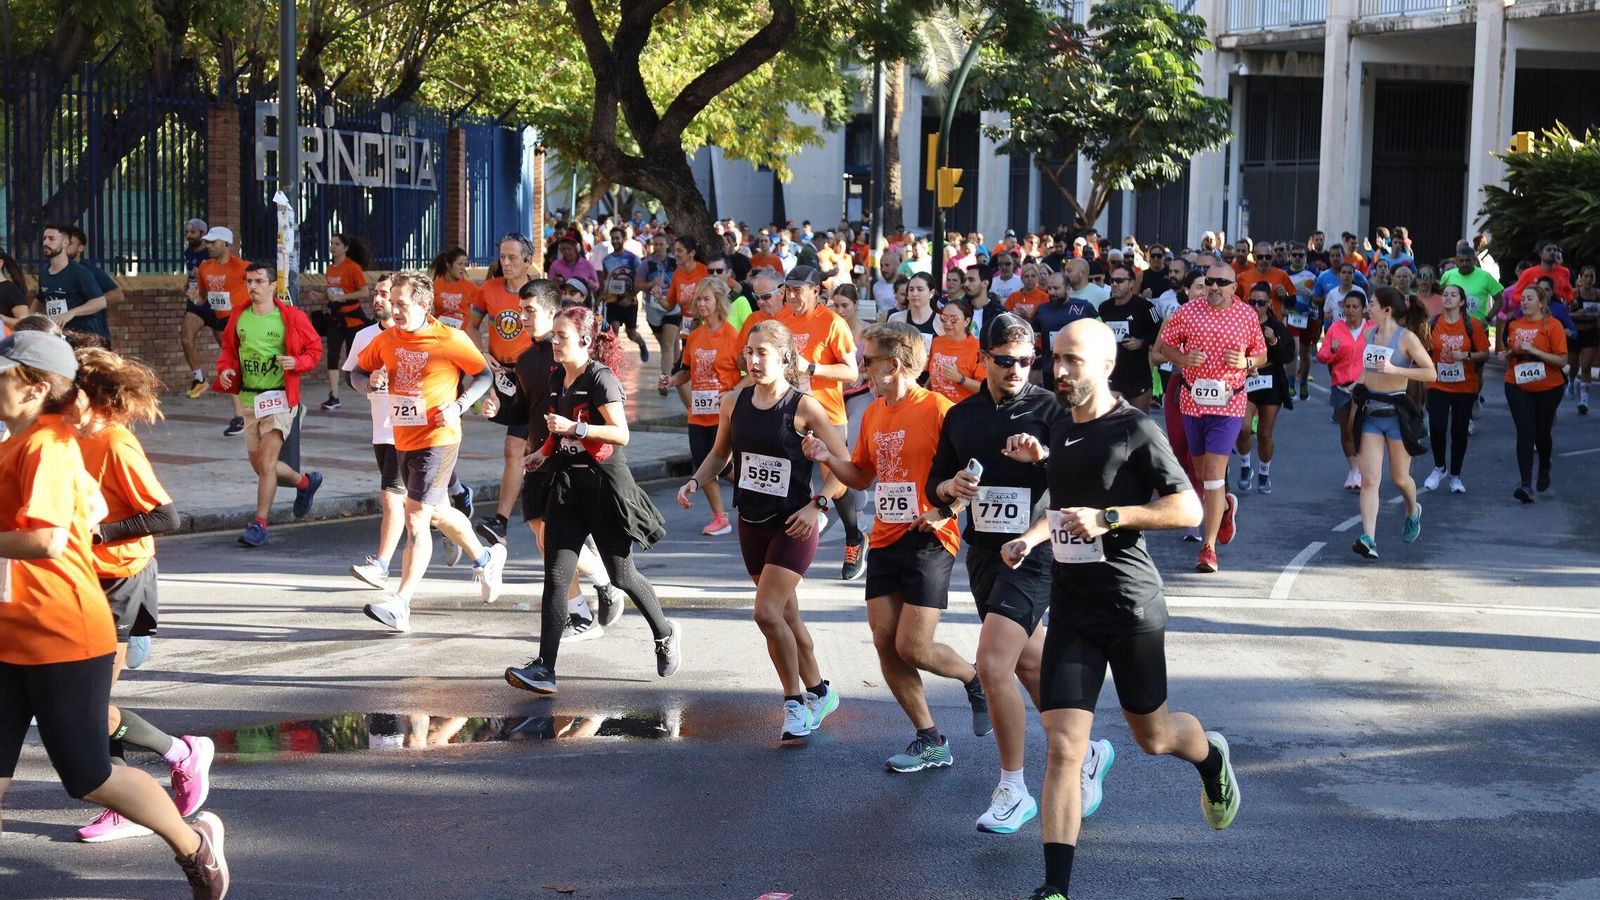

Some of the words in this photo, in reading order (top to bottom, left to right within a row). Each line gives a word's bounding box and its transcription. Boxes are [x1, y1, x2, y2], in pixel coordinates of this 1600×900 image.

[1440, 369, 1460, 377] 443
[1520, 369, 1540, 377] 444
[1195, 388, 1219, 397] 670
[259, 397, 282, 410] 635
[694, 398, 713, 407] 597
[393, 406, 418, 416] 721
[748, 466, 781, 483] 595
[879, 497, 908, 511] 276
[978, 503, 1019, 518] 770
